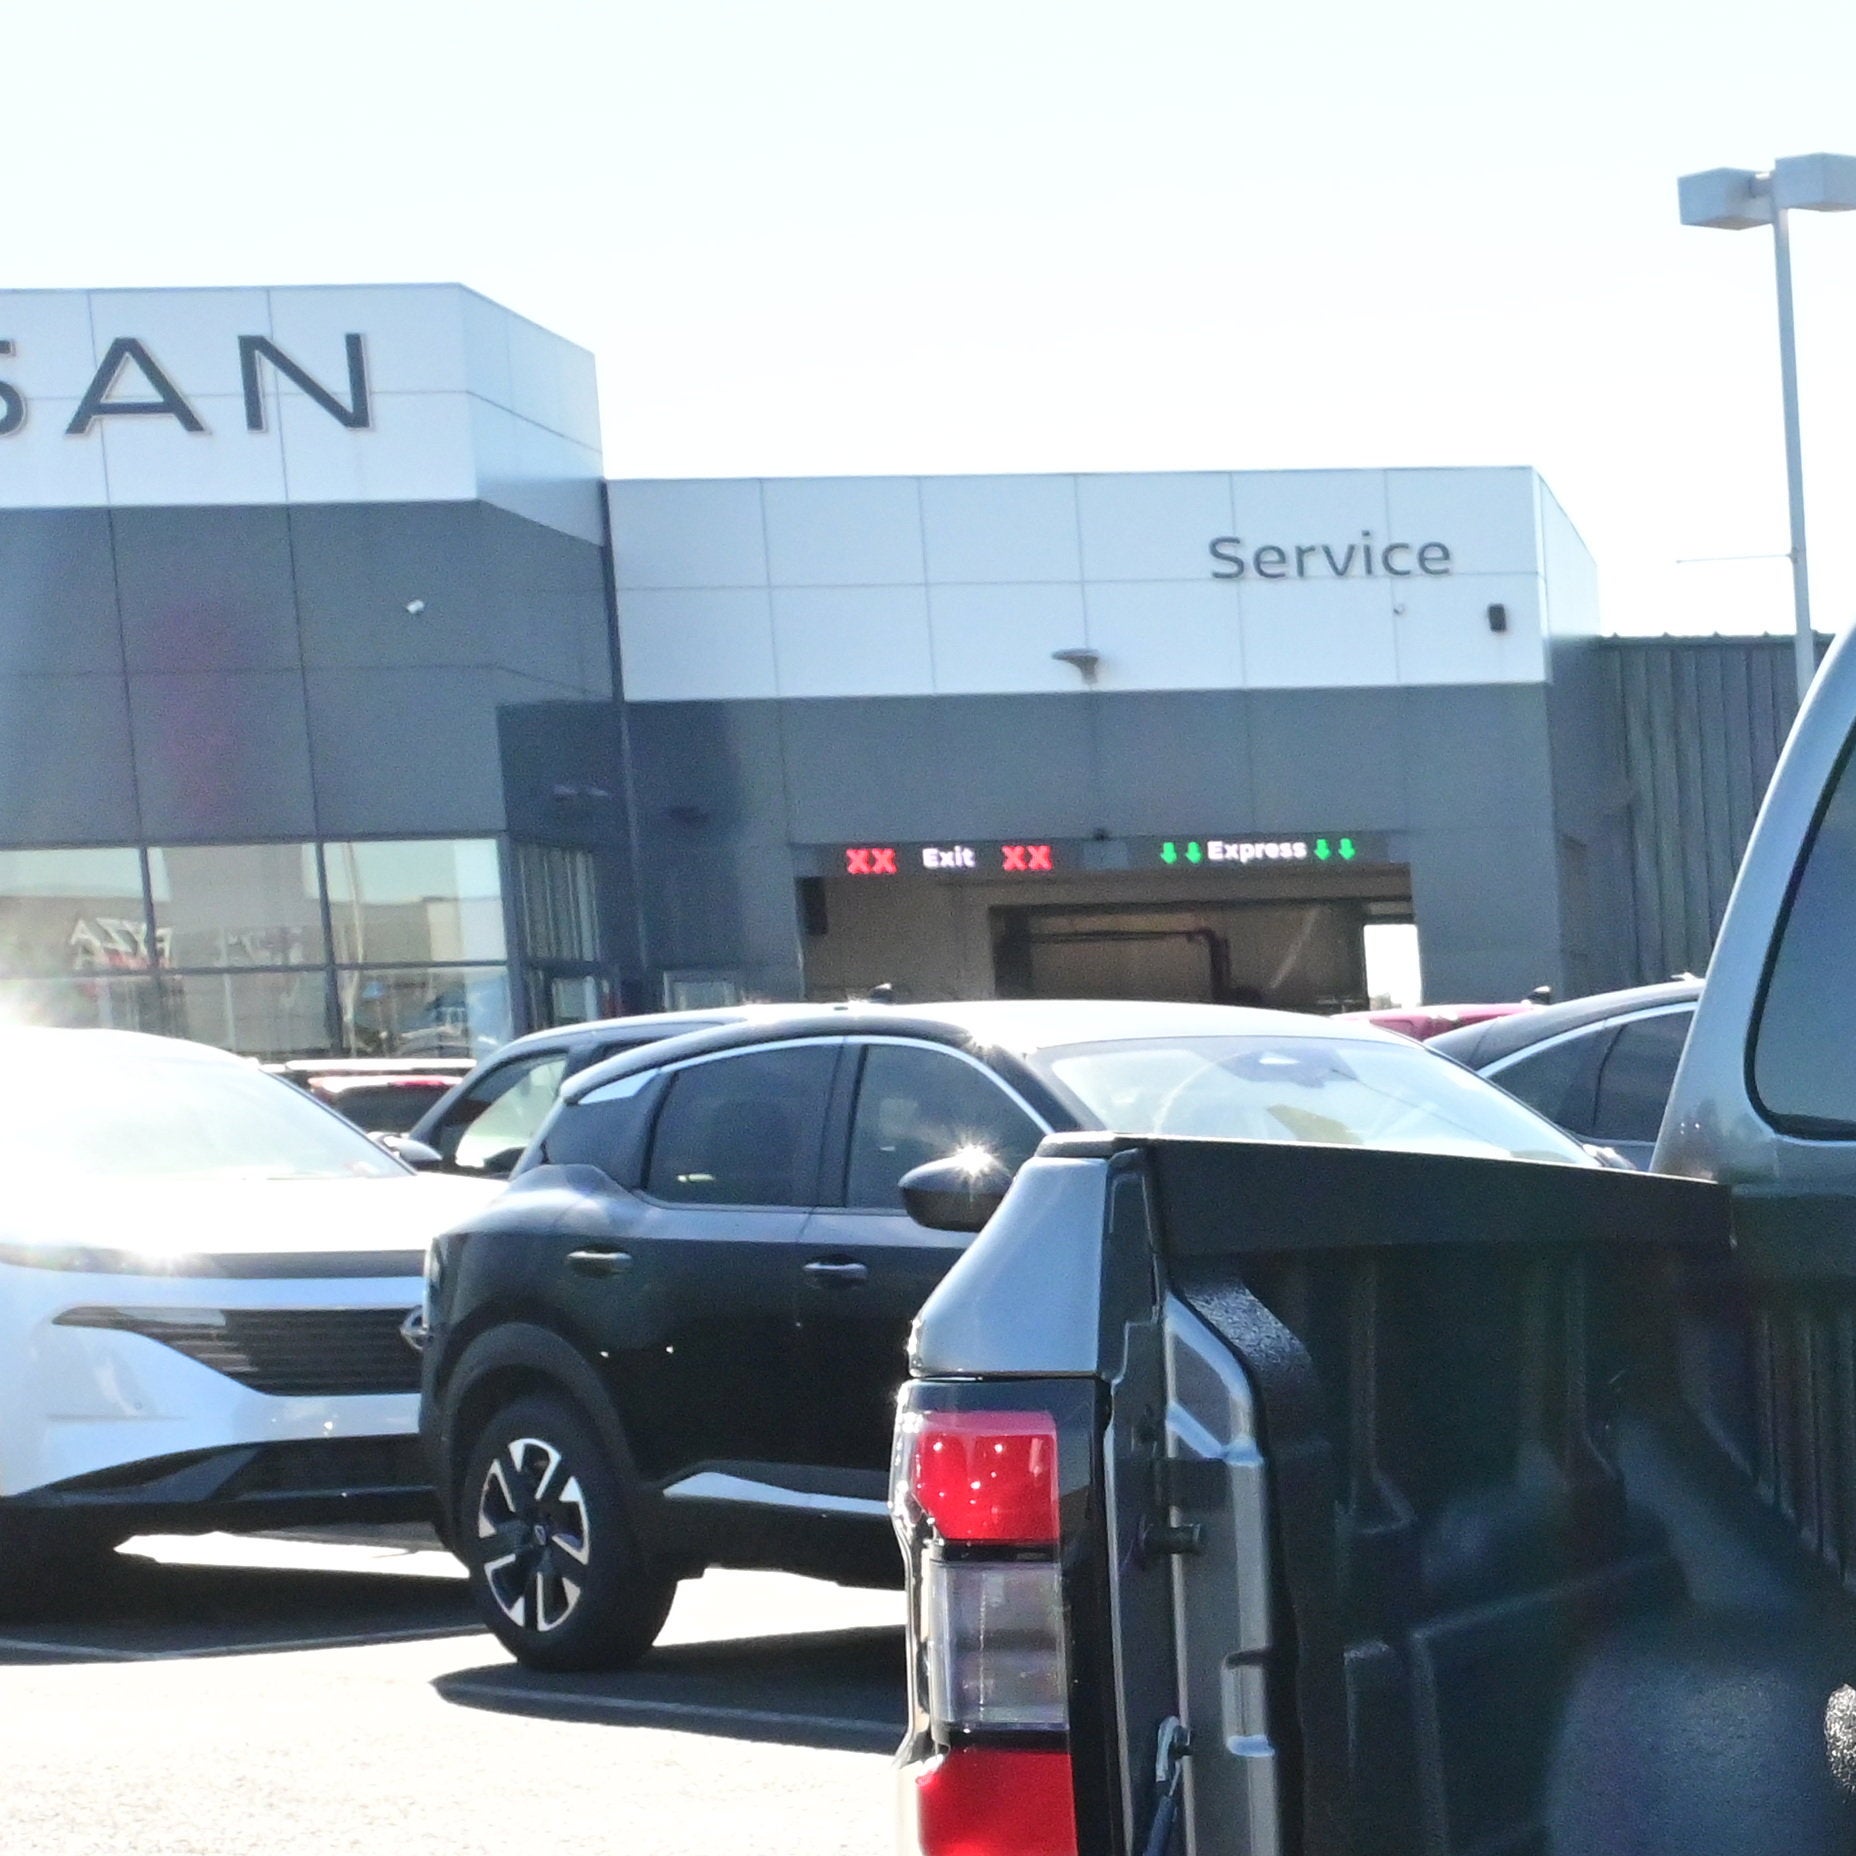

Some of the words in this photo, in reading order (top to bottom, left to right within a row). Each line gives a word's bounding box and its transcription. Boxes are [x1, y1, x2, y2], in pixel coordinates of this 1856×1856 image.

[0, 332, 372, 436] AN
[1208, 529, 1453, 579] Service
[922, 845, 976, 868] Exit
[1207, 840, 1308, 863] Express
